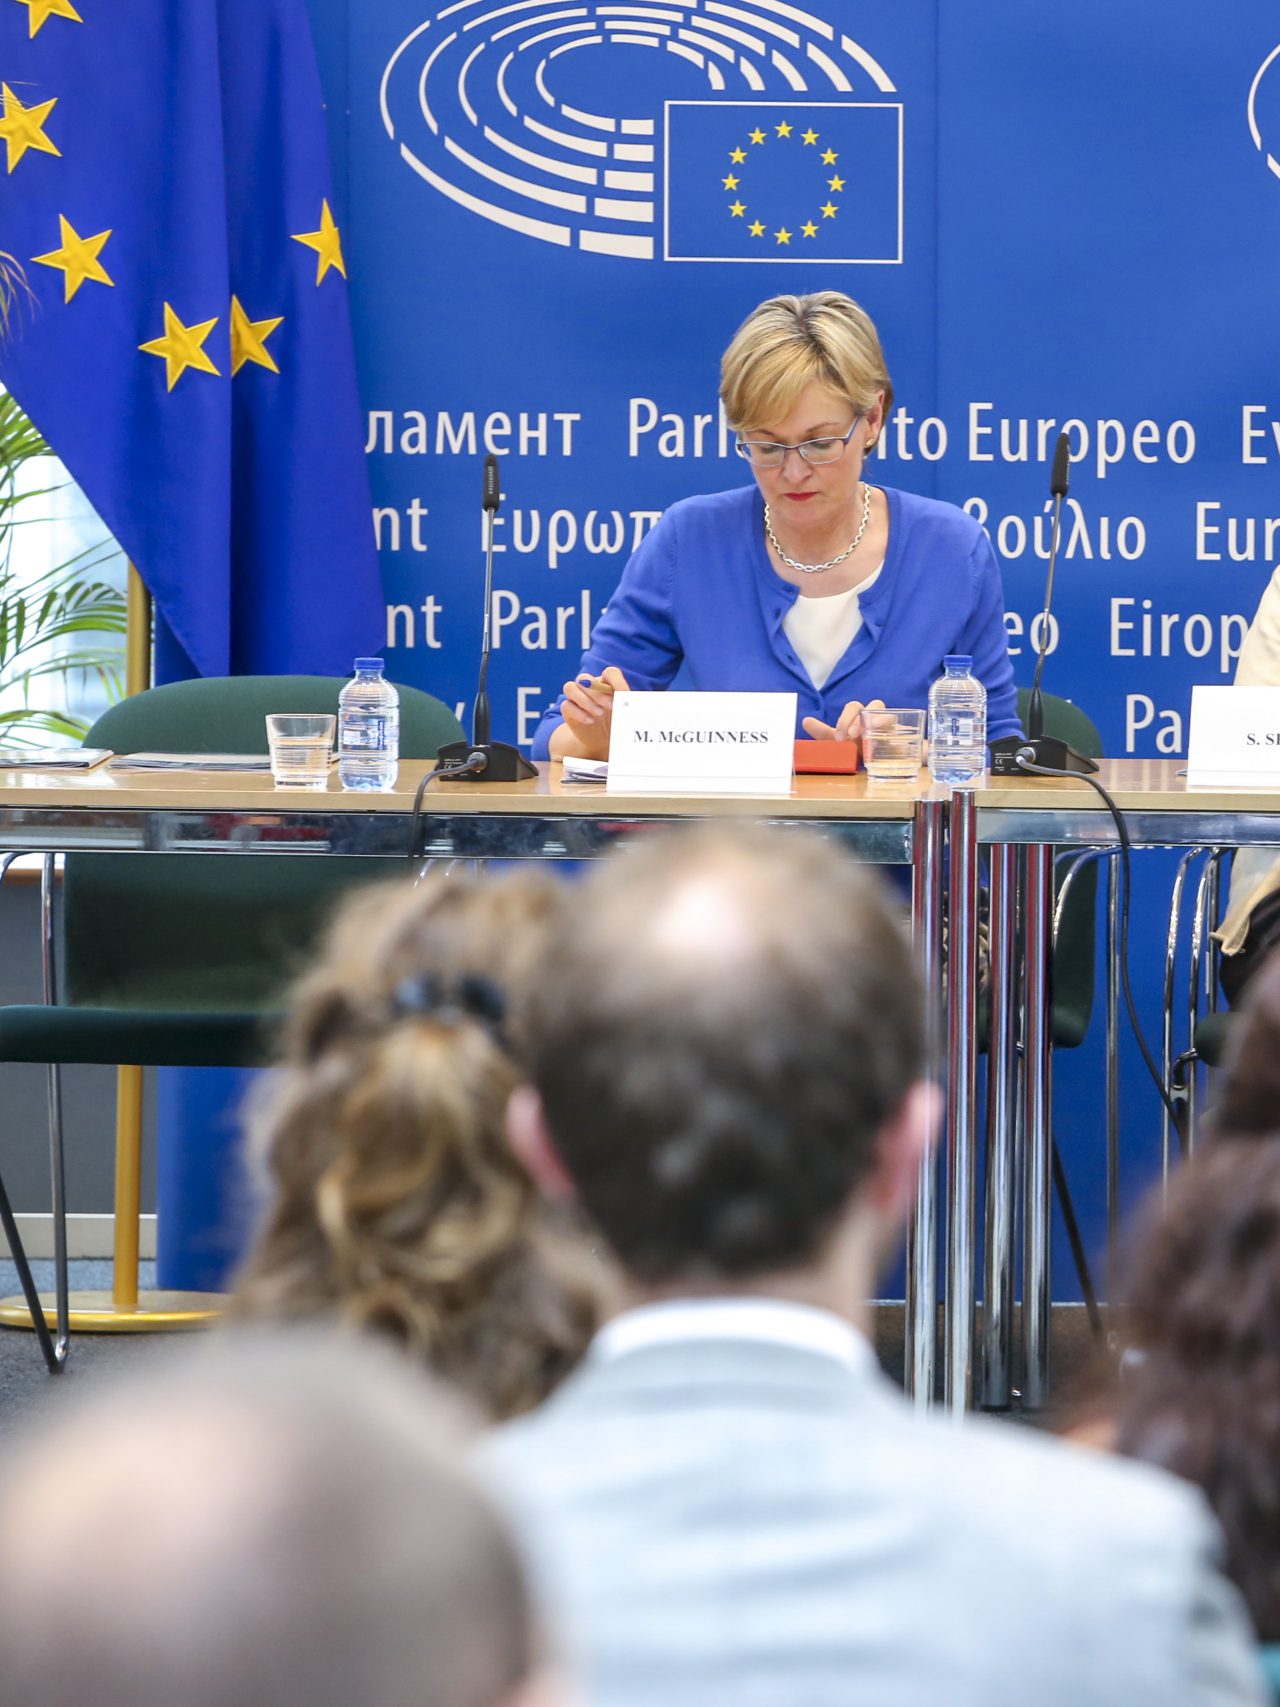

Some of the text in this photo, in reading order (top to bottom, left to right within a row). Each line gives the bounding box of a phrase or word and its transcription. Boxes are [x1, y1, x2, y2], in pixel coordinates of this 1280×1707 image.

[969, 403, 1196, 479] Europeo
[491, 589, 607, 650] Parl
[634, 730, 769, 744] M. McGUINNESS
[1246, 733, 1260, 746] S.
